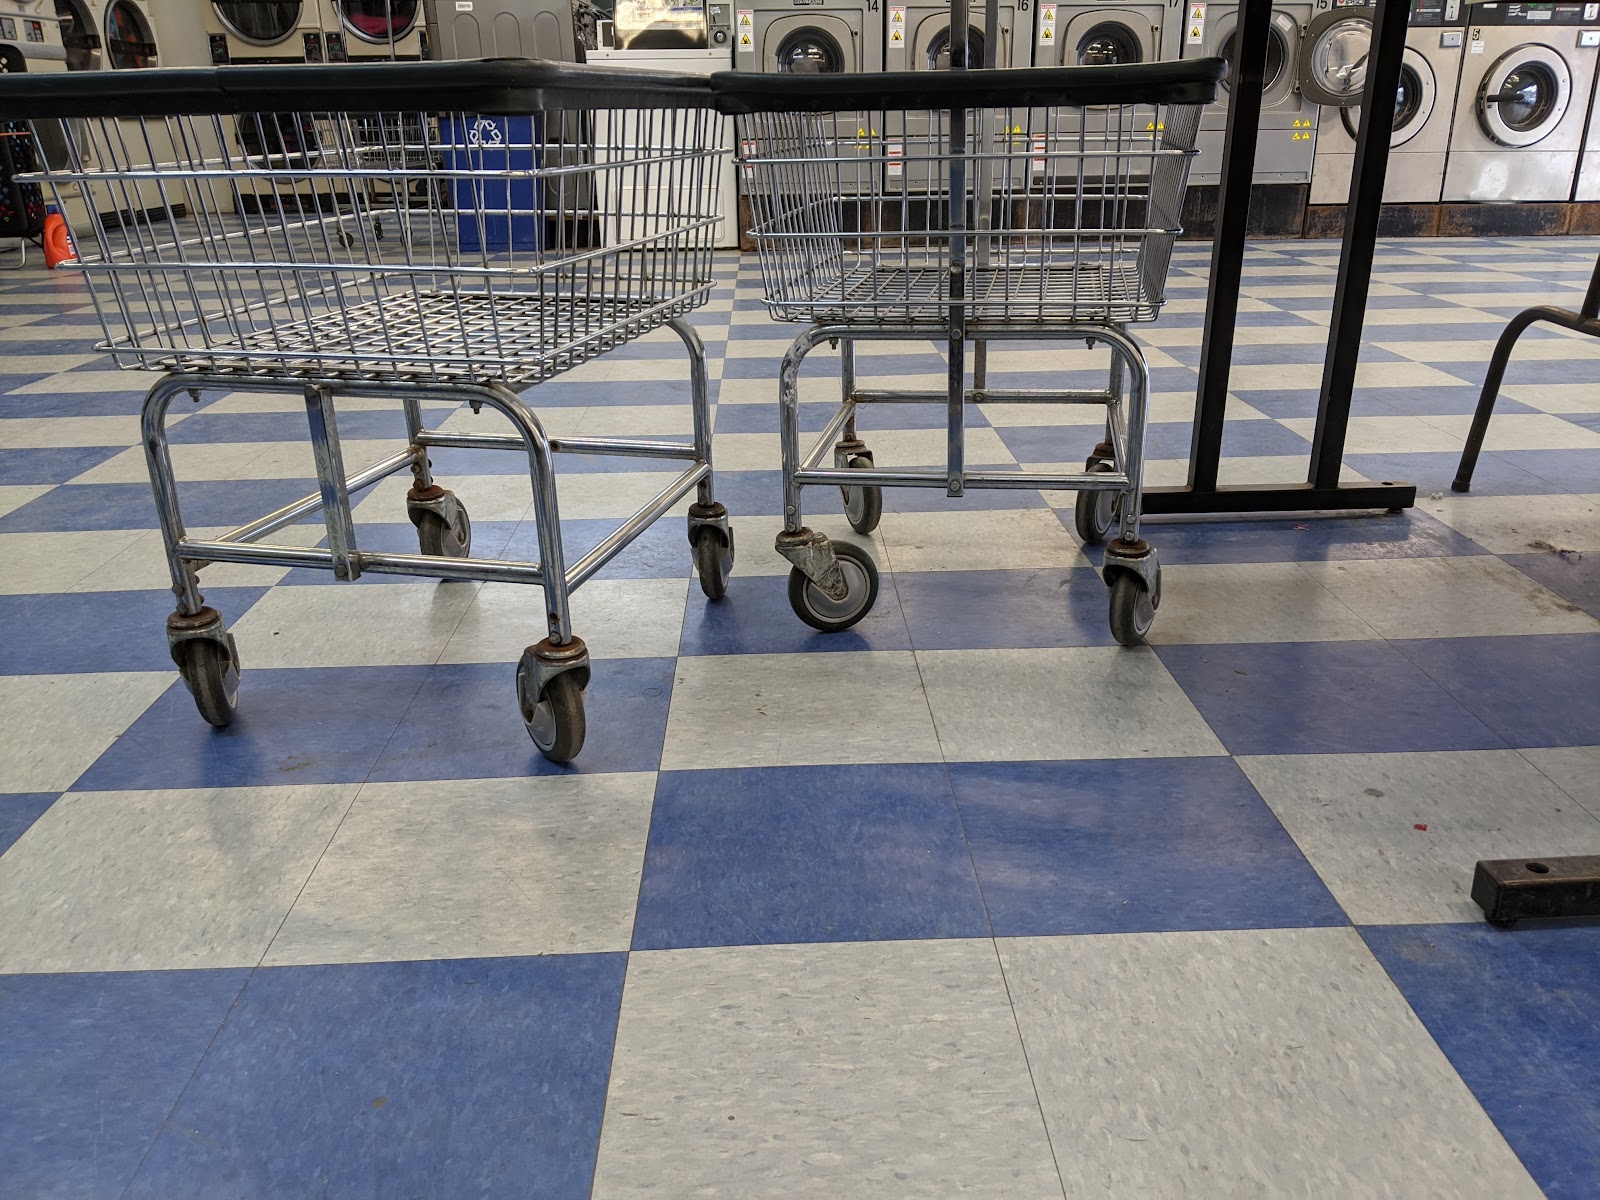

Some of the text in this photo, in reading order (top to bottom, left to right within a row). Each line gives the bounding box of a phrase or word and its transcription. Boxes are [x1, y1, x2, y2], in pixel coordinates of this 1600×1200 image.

[866, 0, 879, 12] 14
[1017, 0, 1029, 11] 16
[1316, 0, 1328, 9] 15
[1472, 28, 1481, 40] 5
